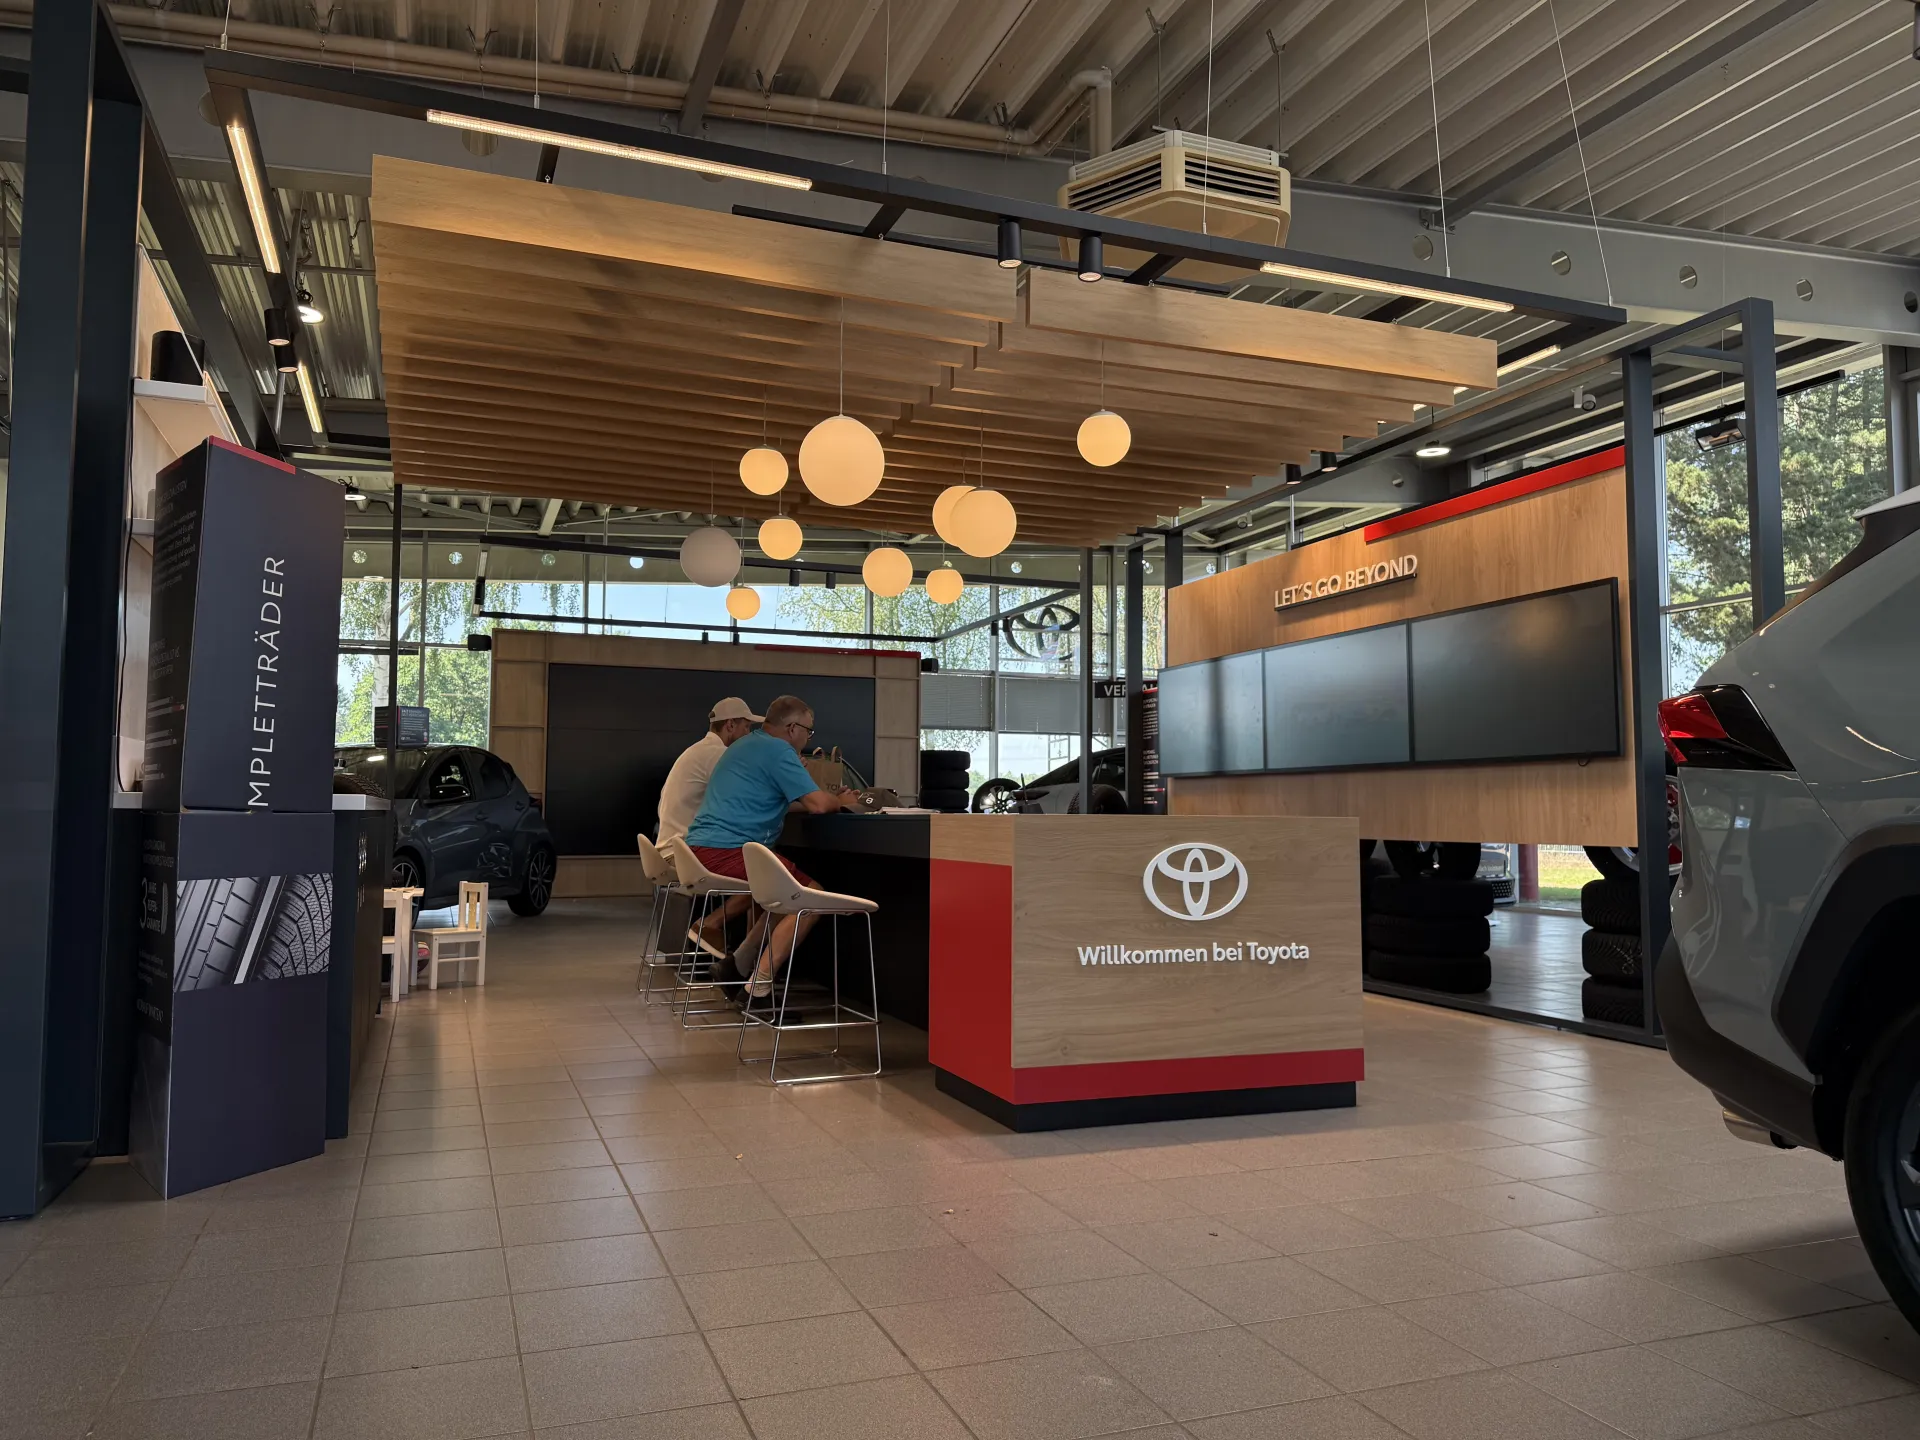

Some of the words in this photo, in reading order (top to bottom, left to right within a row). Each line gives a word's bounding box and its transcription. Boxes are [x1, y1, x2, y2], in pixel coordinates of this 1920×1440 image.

[1315, 575, 1342, 597] GO
[1345, 555, 1418, 590] BEYOND
[247, 556, 286, 807] MPLETTRÄDER
[1077, 944, 1208, 966] Willkommen
[1212, 941, 1243, 962] bei
[1246, 941, 1310, 965] Toyota
